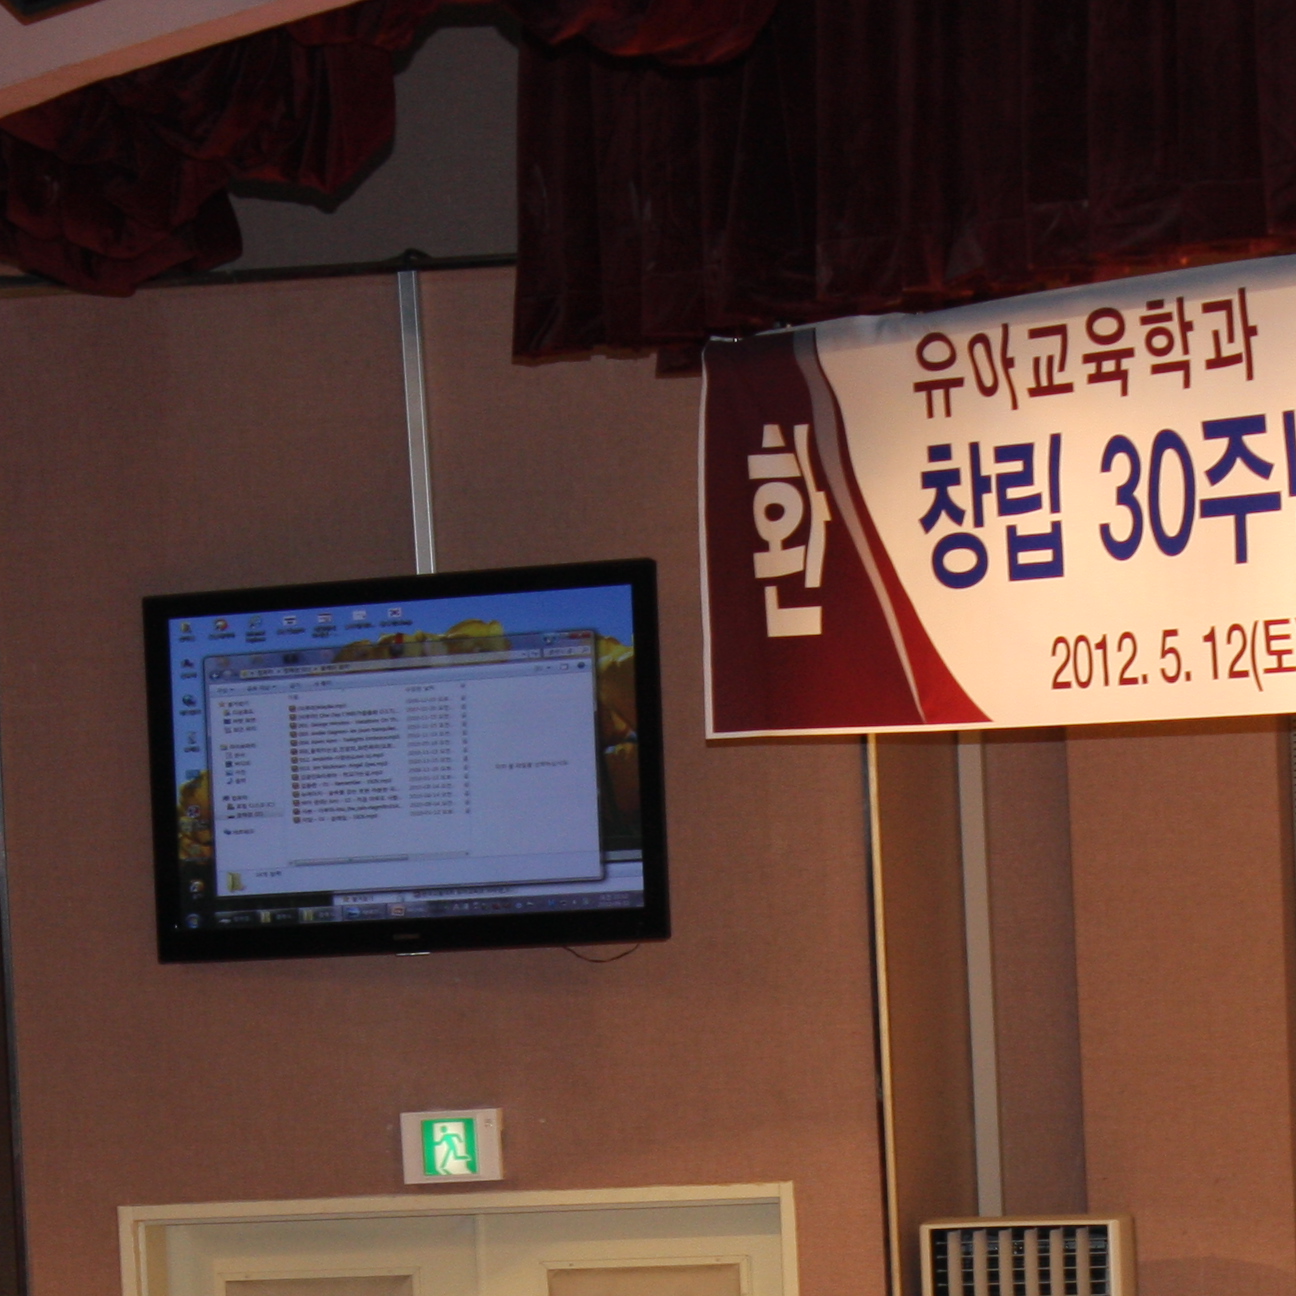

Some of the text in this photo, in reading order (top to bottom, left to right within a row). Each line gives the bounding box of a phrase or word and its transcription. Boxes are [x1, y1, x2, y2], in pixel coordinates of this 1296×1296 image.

[912, 286, 1260, 420] 유아교육학과
[748, 423, 831, 638] 환
[919, 432, 1065, 590] 창립
